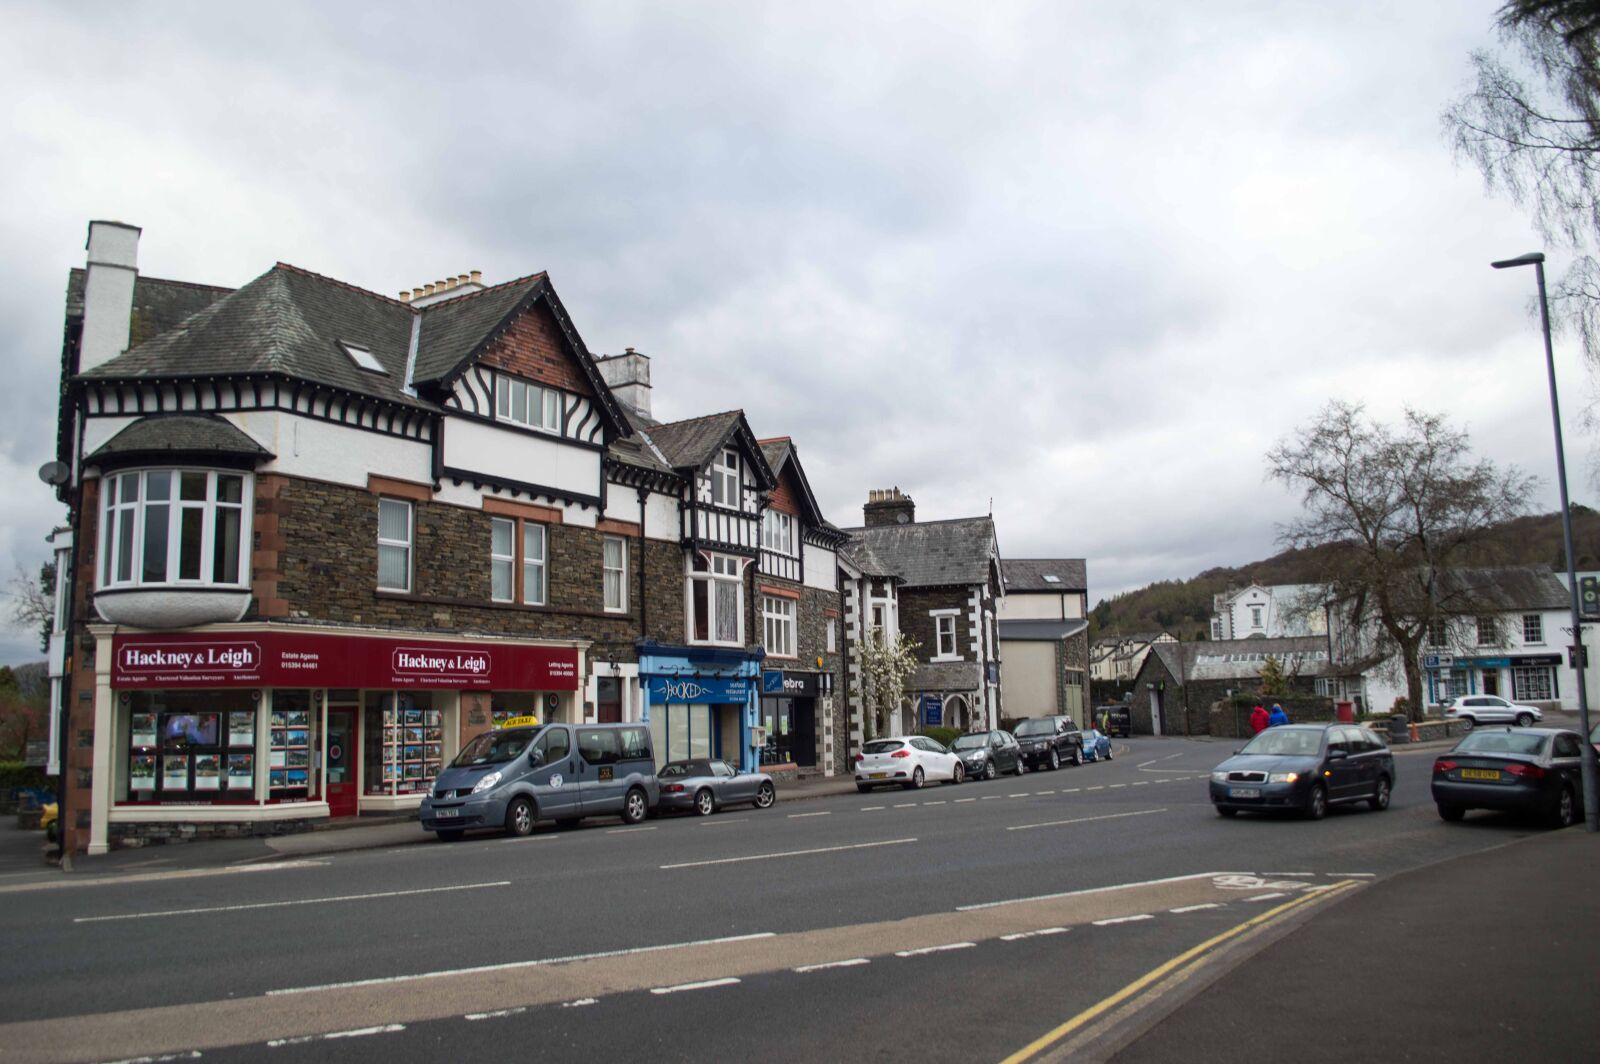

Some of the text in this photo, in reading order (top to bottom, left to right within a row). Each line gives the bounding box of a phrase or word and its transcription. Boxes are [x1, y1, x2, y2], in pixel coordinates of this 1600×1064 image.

[126, 648, 252, 668] Hackney & Leigh
[281, 651, 319, 661] Estate Agents
[398, 653, 448, 672] Hackney
[448, 659, 455, 669] &
[457, 656, 486, 673] Leigh
[784, 678, 804, 689] ebra
